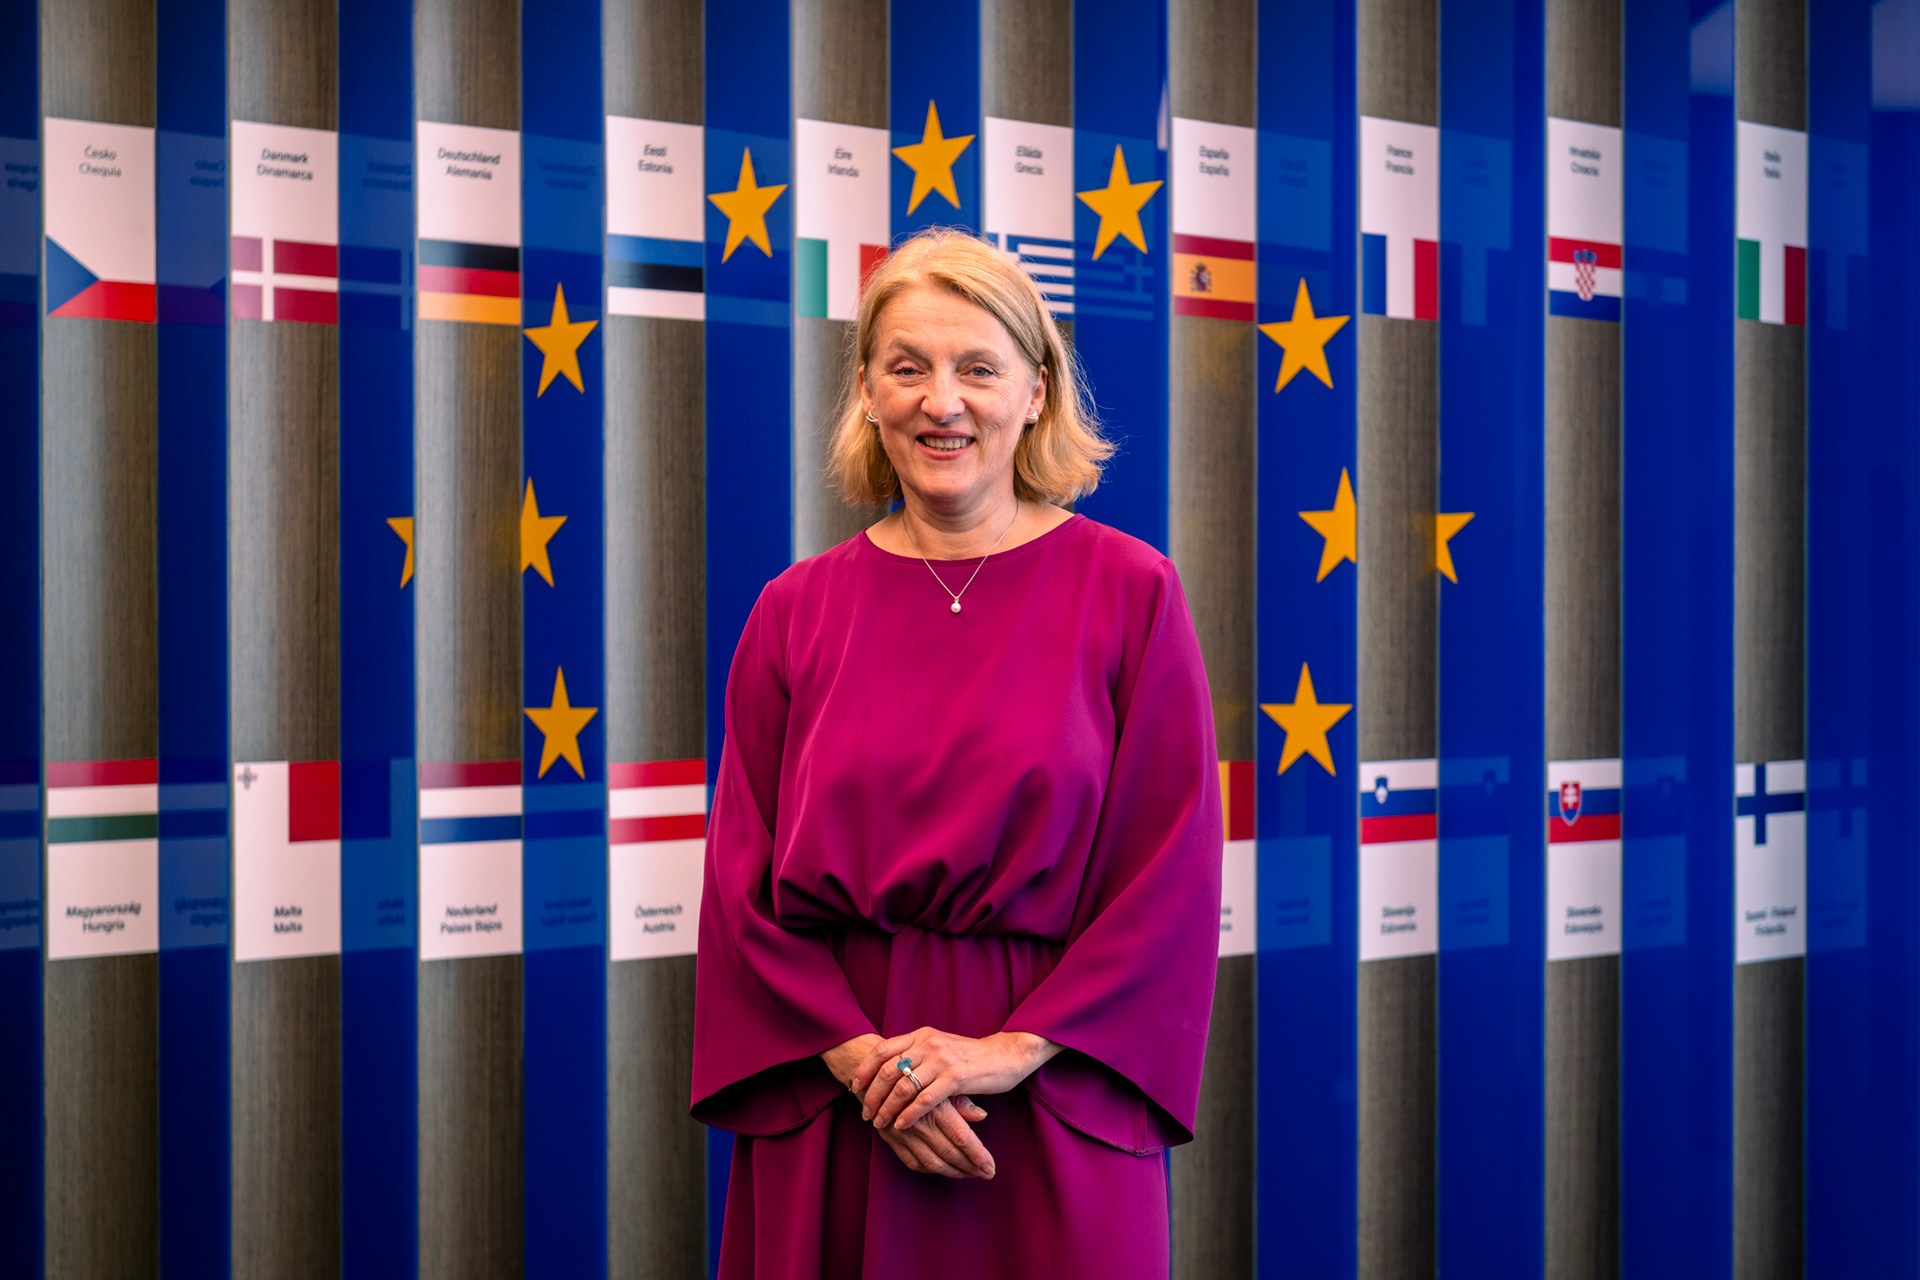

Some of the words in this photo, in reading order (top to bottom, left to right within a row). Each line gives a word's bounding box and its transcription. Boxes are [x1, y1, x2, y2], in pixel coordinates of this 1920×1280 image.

[262, 149, 308, 163] Danmark
[438, 148, 501, 165] Deutschland
[79, 163, 122, 178] Chequia
[257, 164, 313, 180] Dinamarca
[446, 165, 493, 180] Alemania
[638, 160, 673, 174] Estonia
[274, 905, 303, 917] Malta
[446, 903, 497, 917] Nederland
[274, 921, 303, 933] Malta
[643, 921, 676, 933] Austria
